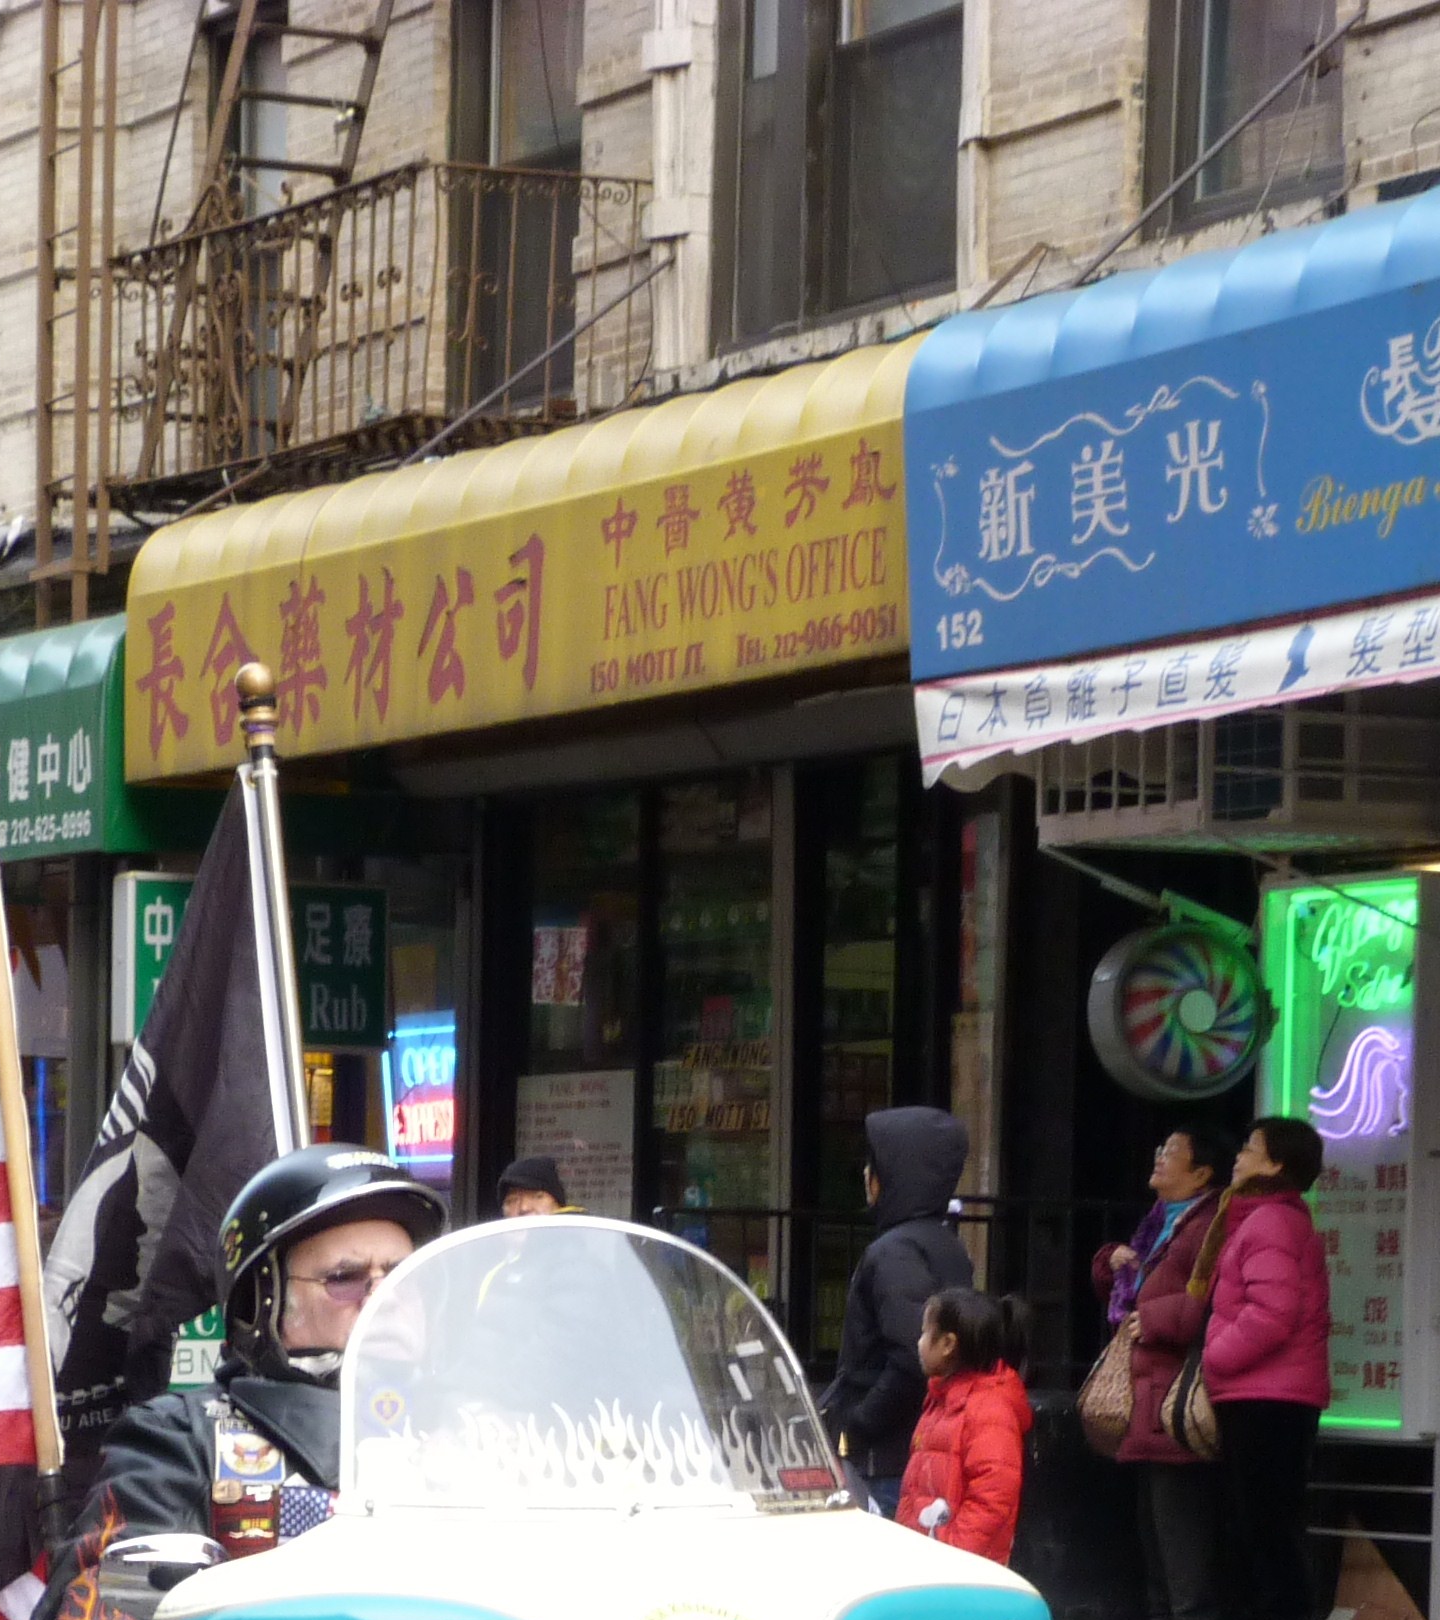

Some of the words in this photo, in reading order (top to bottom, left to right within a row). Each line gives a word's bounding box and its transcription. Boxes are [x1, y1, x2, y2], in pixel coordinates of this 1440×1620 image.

[977, 418, 1228, 563] 新美光
[1296, 473, 1429, 539] Bienga
[603, 572, 669, 641] FANG
[676, 548, 780, 622] WONG'S
[786, 526, 889, 604] OFFICE
[590, 660, 620, 694] 150
[626, 647, 677, 685] MOTT
[773, 603, 898, 660] 212-966-9051
[935, 609, 984, 652] 152
[309, 983, 369, 1033] Rub
[668, 1103, 696, 1132] 150
